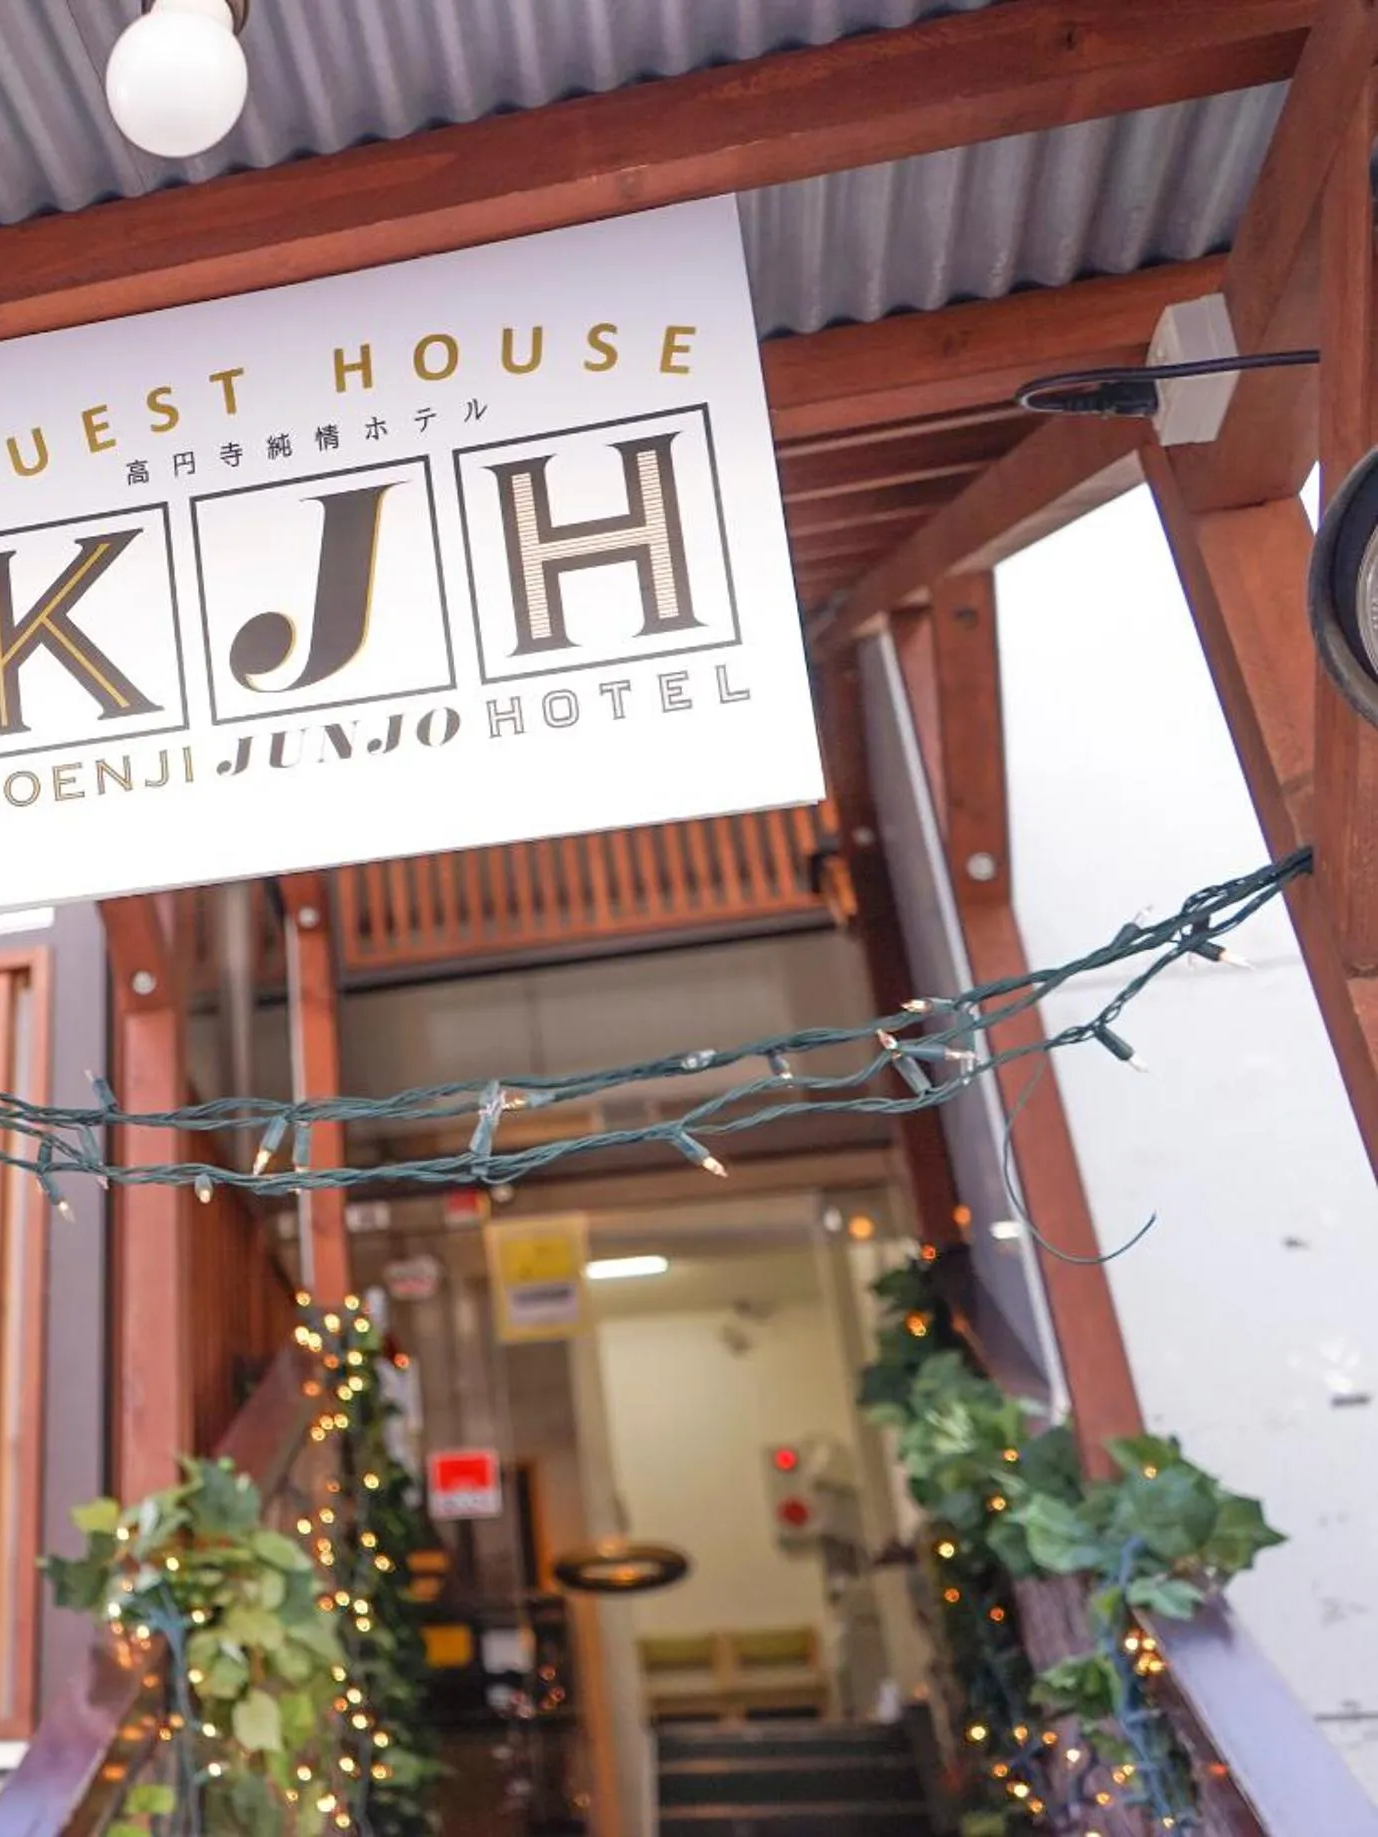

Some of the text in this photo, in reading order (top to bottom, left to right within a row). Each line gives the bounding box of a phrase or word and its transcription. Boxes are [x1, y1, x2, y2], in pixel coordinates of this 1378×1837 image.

[333, 322, 697, 394] HOUSE
[125, 397, 489, 487] 高円寺純情ホテル
[216, 706, 461, 777] JUNJO
[486, 664, 751, 739] HOTEL
